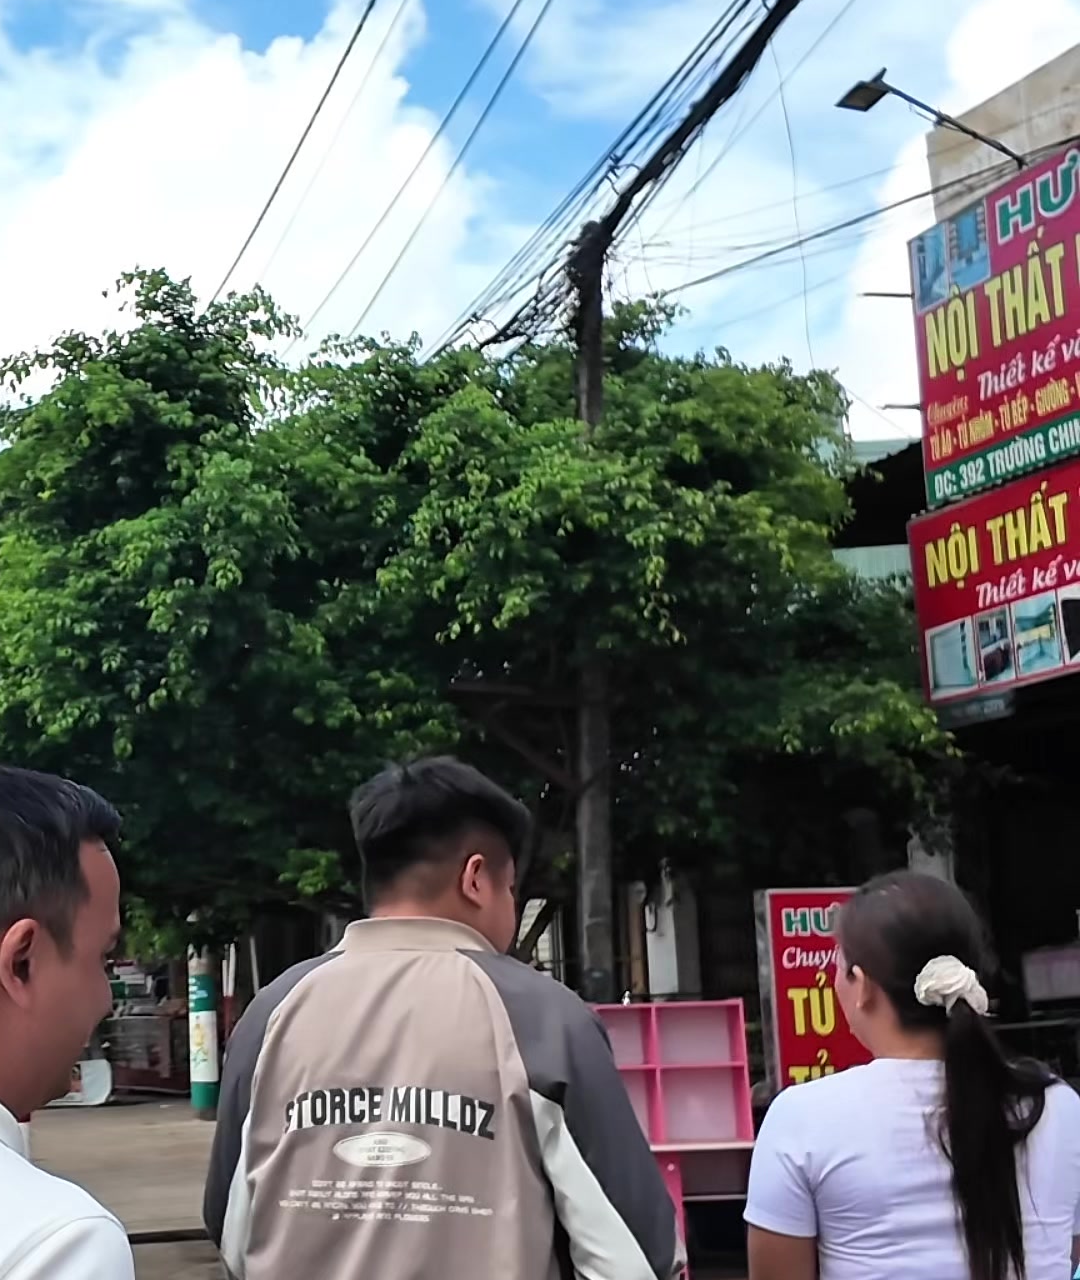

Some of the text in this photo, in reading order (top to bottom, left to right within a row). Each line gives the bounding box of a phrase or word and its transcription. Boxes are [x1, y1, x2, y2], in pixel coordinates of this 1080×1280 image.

[925, 284, 979, 382] NỘI
[983, 225, 1065, 347] THẤT
[978, 351, 1026, 401] Thiết
[1031, 333, 1060, 377] kế
[959, 457, 985, 489] 392
[986, 433, 1046, 478] TRƯỜNG
[925, 481, 1068, 589] NỘI THẤT
[976, 568, 1026, 608] Thiết
[1032, 554, 1062, 593] kế
[787, 971, 836, 1036] TỦ
